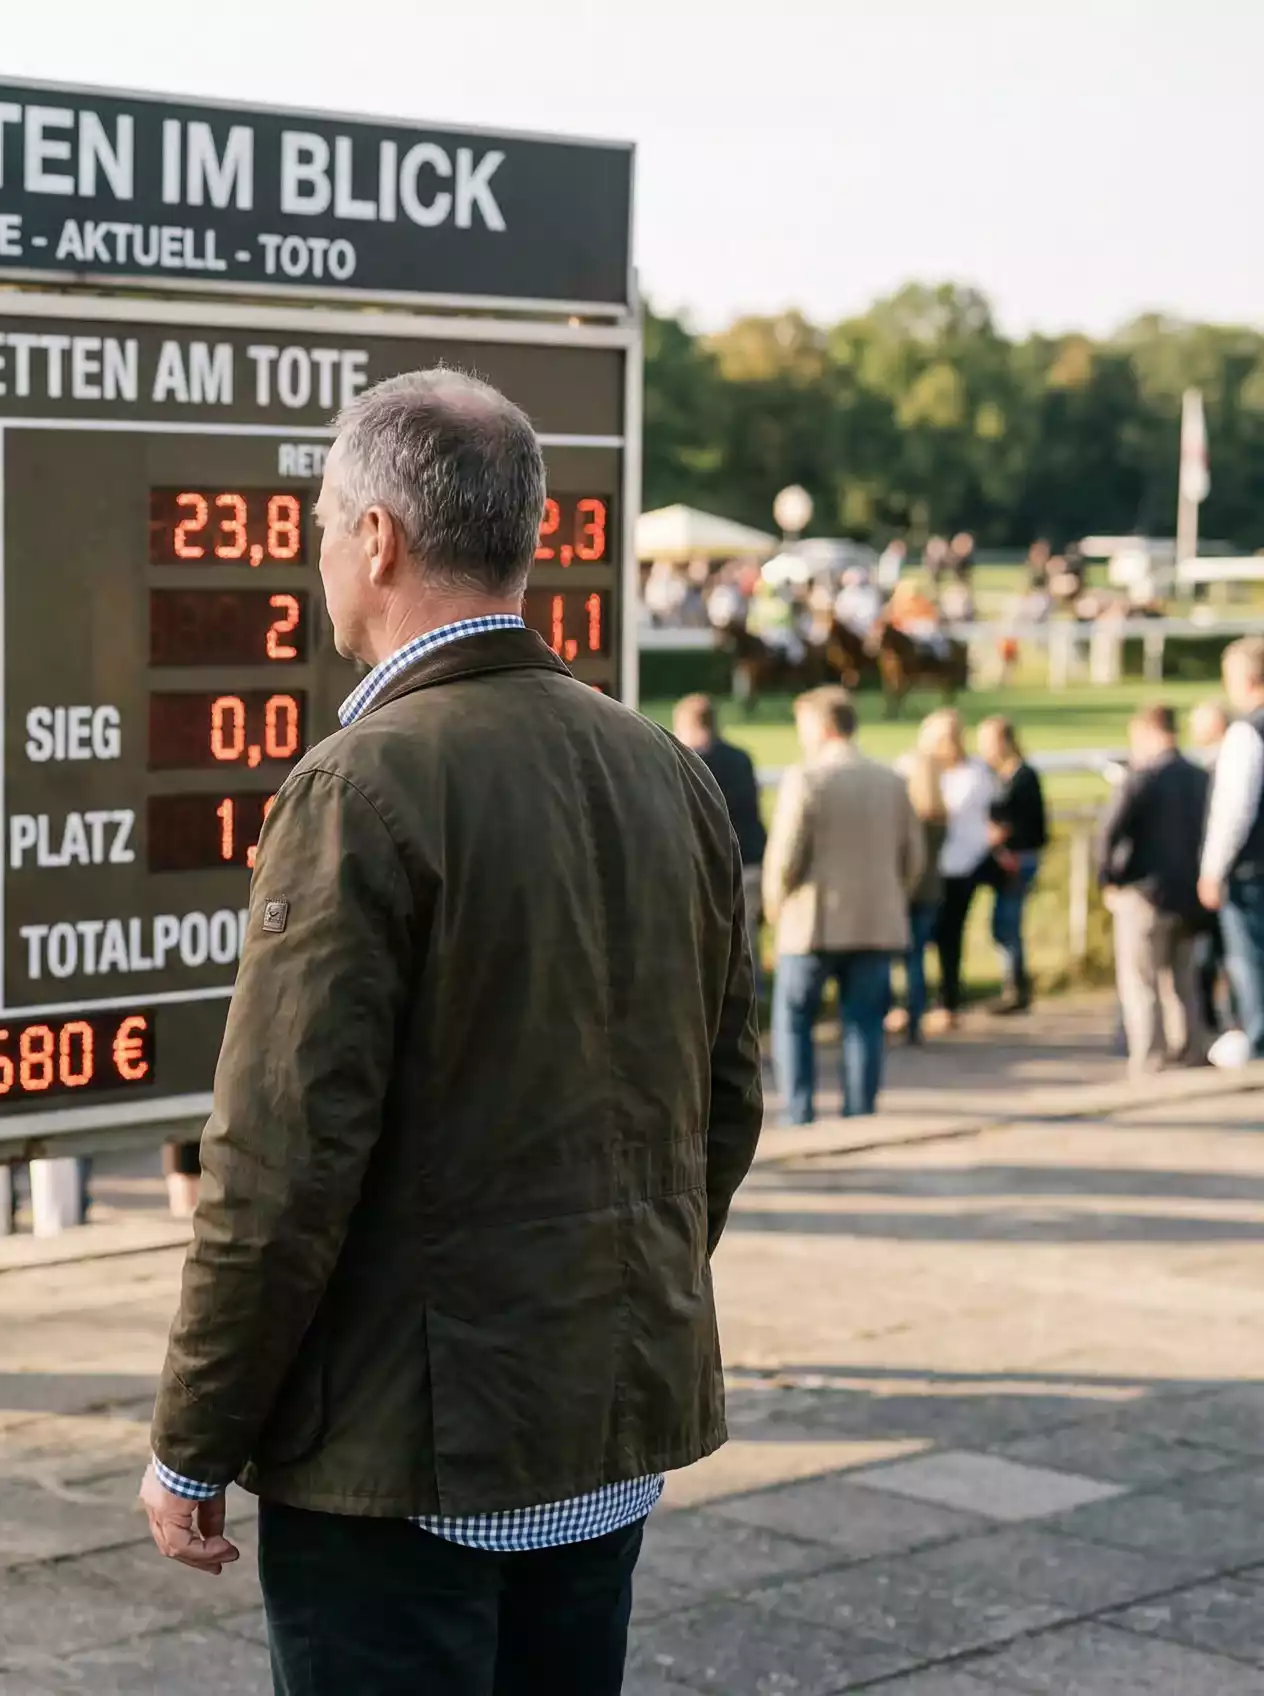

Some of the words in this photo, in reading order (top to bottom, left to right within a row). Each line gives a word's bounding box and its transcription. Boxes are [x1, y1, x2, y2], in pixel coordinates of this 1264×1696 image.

[161, 118, 255, 211] IM
[280, 130, 508, 232] BLICK
[55, 219, 227, 271] AKTUELL
[257, 233, 357, 280] TOTO
[152, 340, 234, 404] AM
[247, 345, 369, 409] TOTE
[173, 492, 300, 567] 23,8
[266, 594, 300, 659] 2
[26, 705, 122, 762] SIEG
[210, 694, 299, 768] 0,0
[9, 809, 135, 869] PLATZ
[112, 1015, 149, 1080] €
